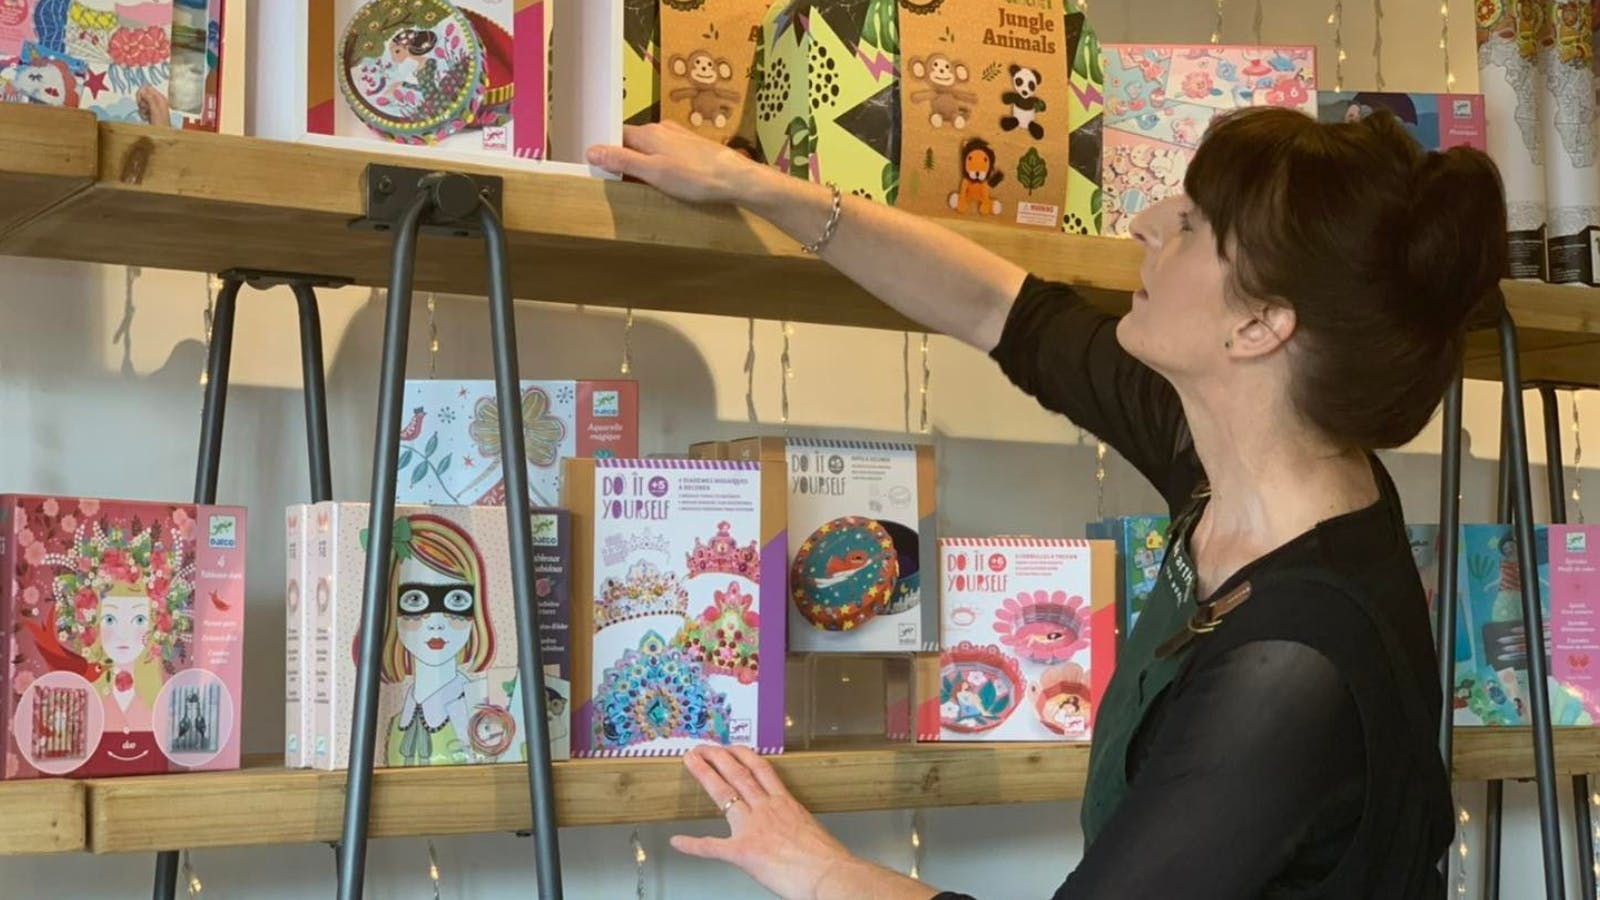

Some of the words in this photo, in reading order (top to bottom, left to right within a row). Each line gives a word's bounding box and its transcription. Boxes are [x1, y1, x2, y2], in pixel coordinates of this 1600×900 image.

[998, 8, 1054, 35] Jungle
[983, 28, 1056, 54] Animals
[792, 454, 809, 473] DO
[603, 475, 624, 496] DO
[792, 476, 847, 496] YOURSELF
[602, 499, 670, 520] YOURSELF
[947, 553, 967, 572] DO
[947, 574, 1008, 593] YOURSELF
